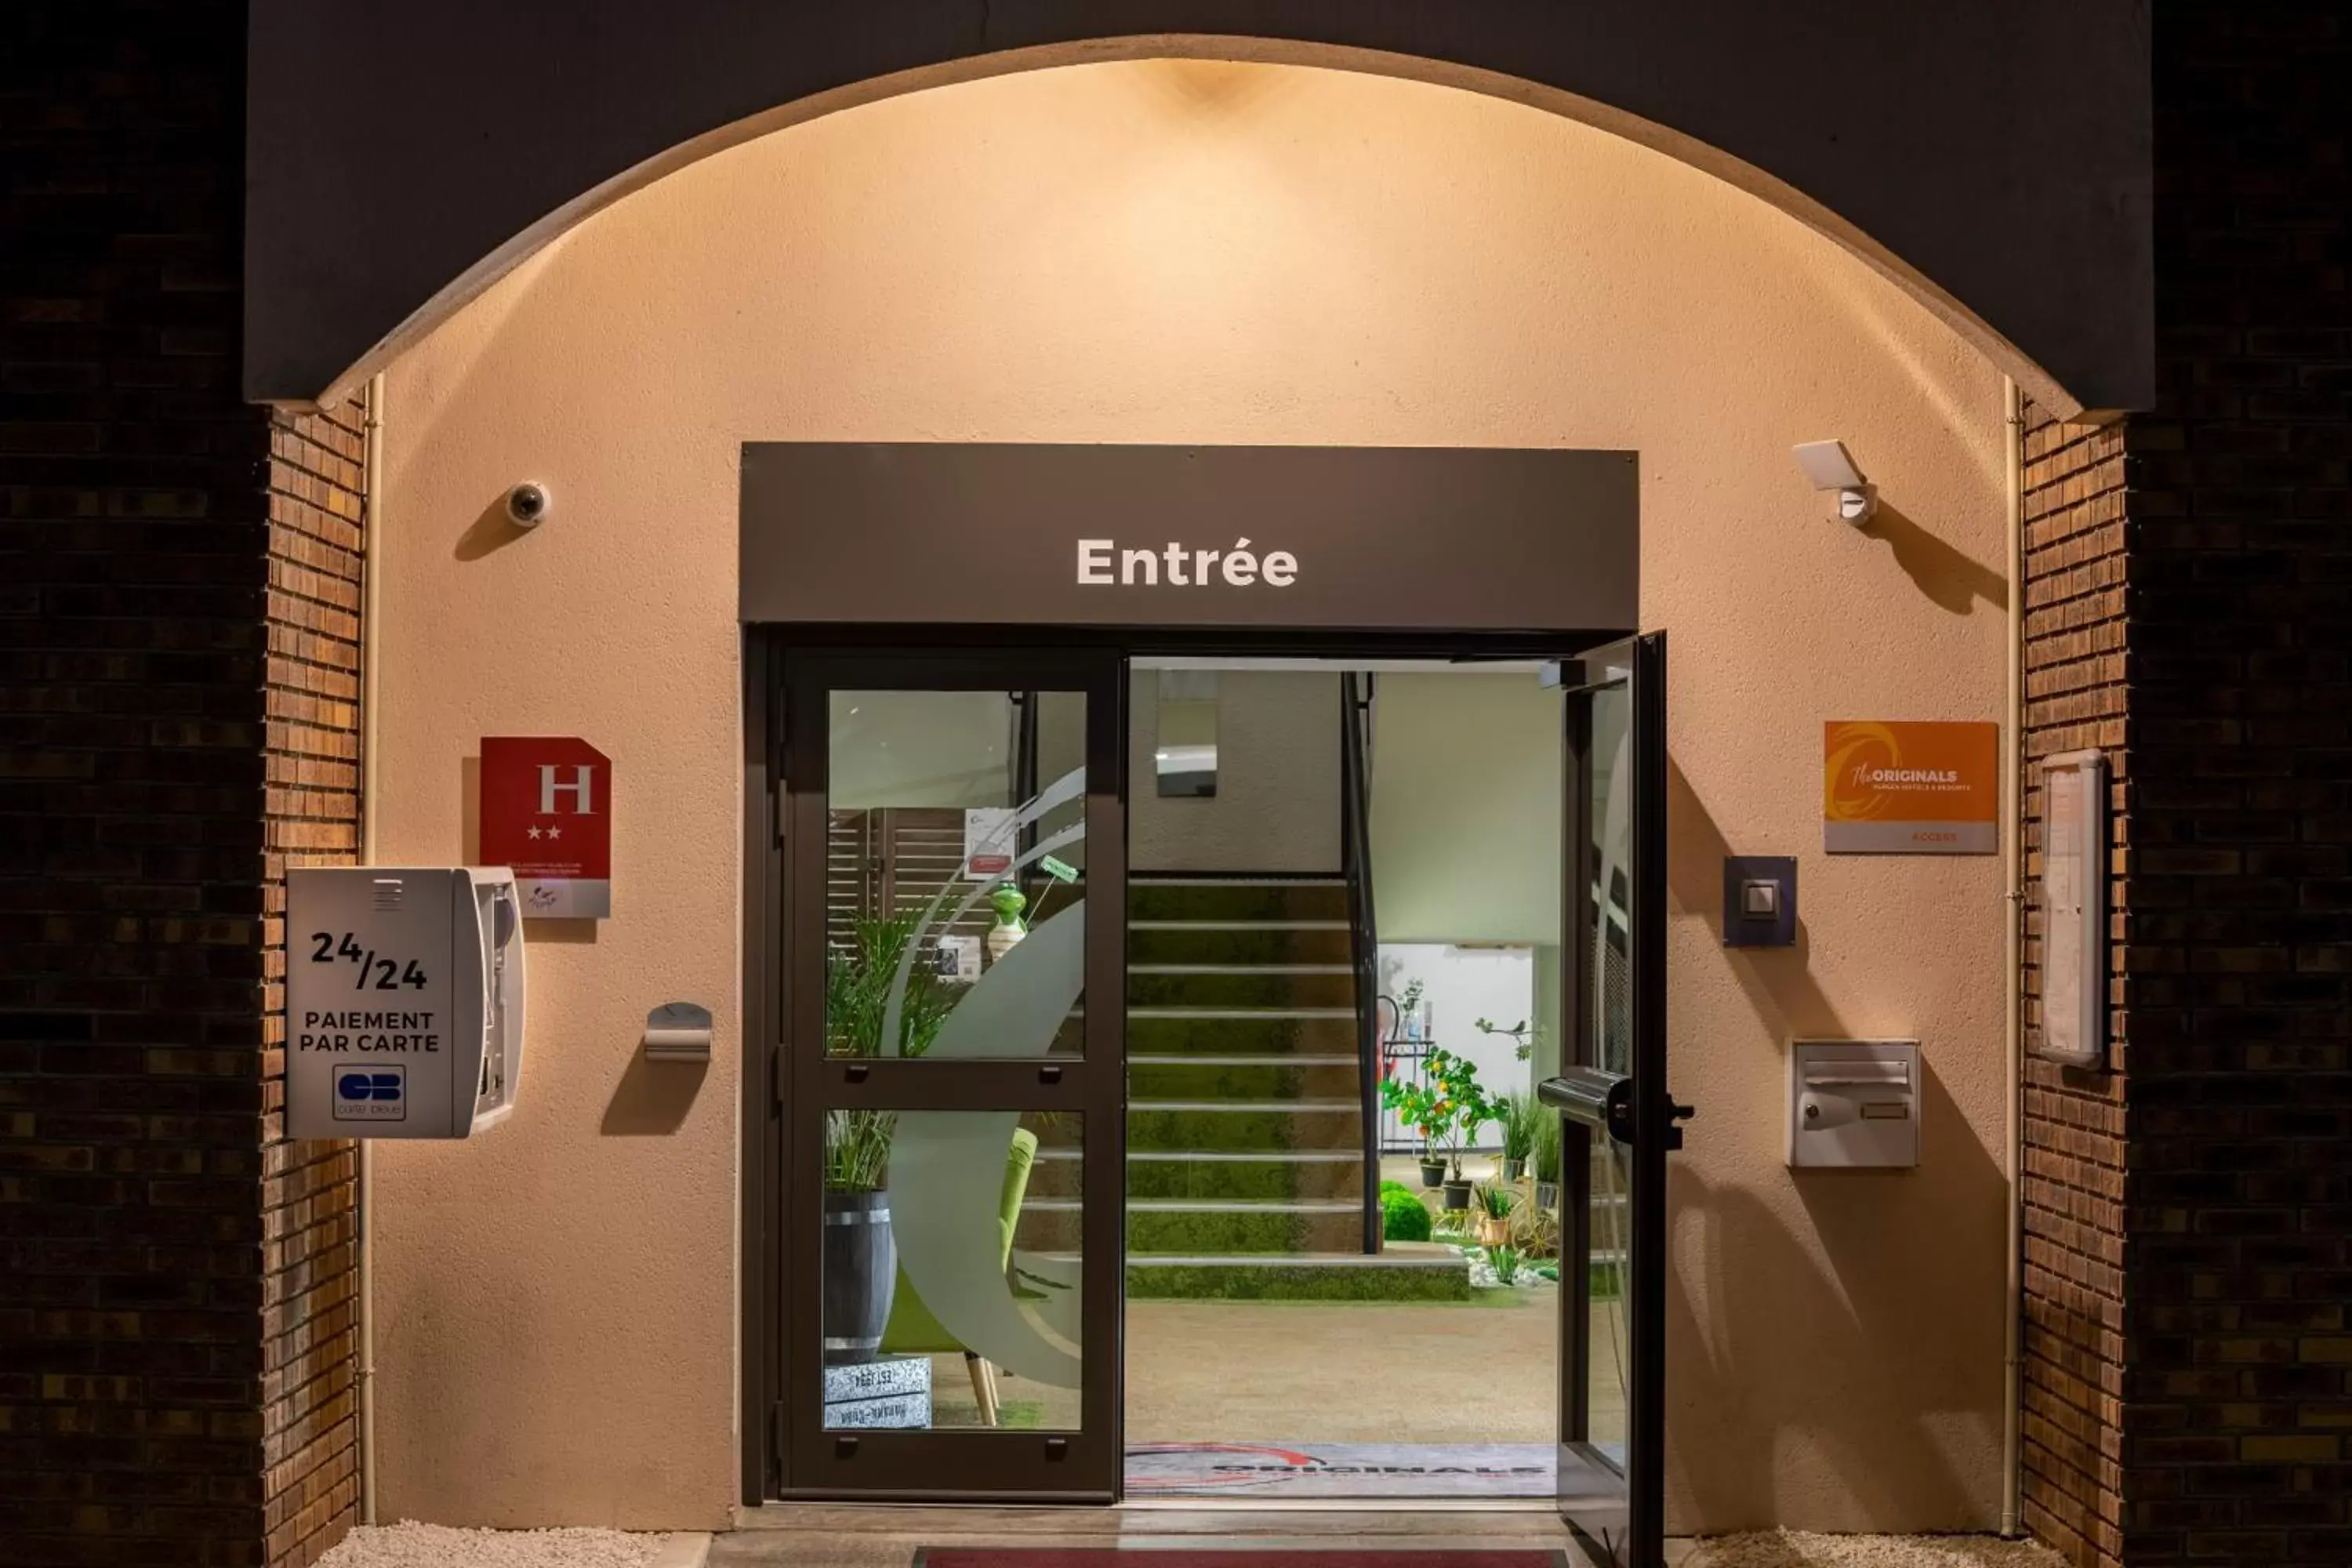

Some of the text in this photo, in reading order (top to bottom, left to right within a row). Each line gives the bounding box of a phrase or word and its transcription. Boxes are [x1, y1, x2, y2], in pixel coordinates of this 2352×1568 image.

[1077, 537, 1298, 586] Entrée
[1872, 769, 1958, 782] ORIGINALS
[535, 764, 601, 815] H
[1911, 832, 1957, 842] ACCESS
[311, 932, 427, 990] 24/24
[305, 1011, 434, 1029] PAIEMENT
[299, 1034, 439, 1052] PAR CARTE
[1211, 1465, 1548, 1474] ORIGINALS
